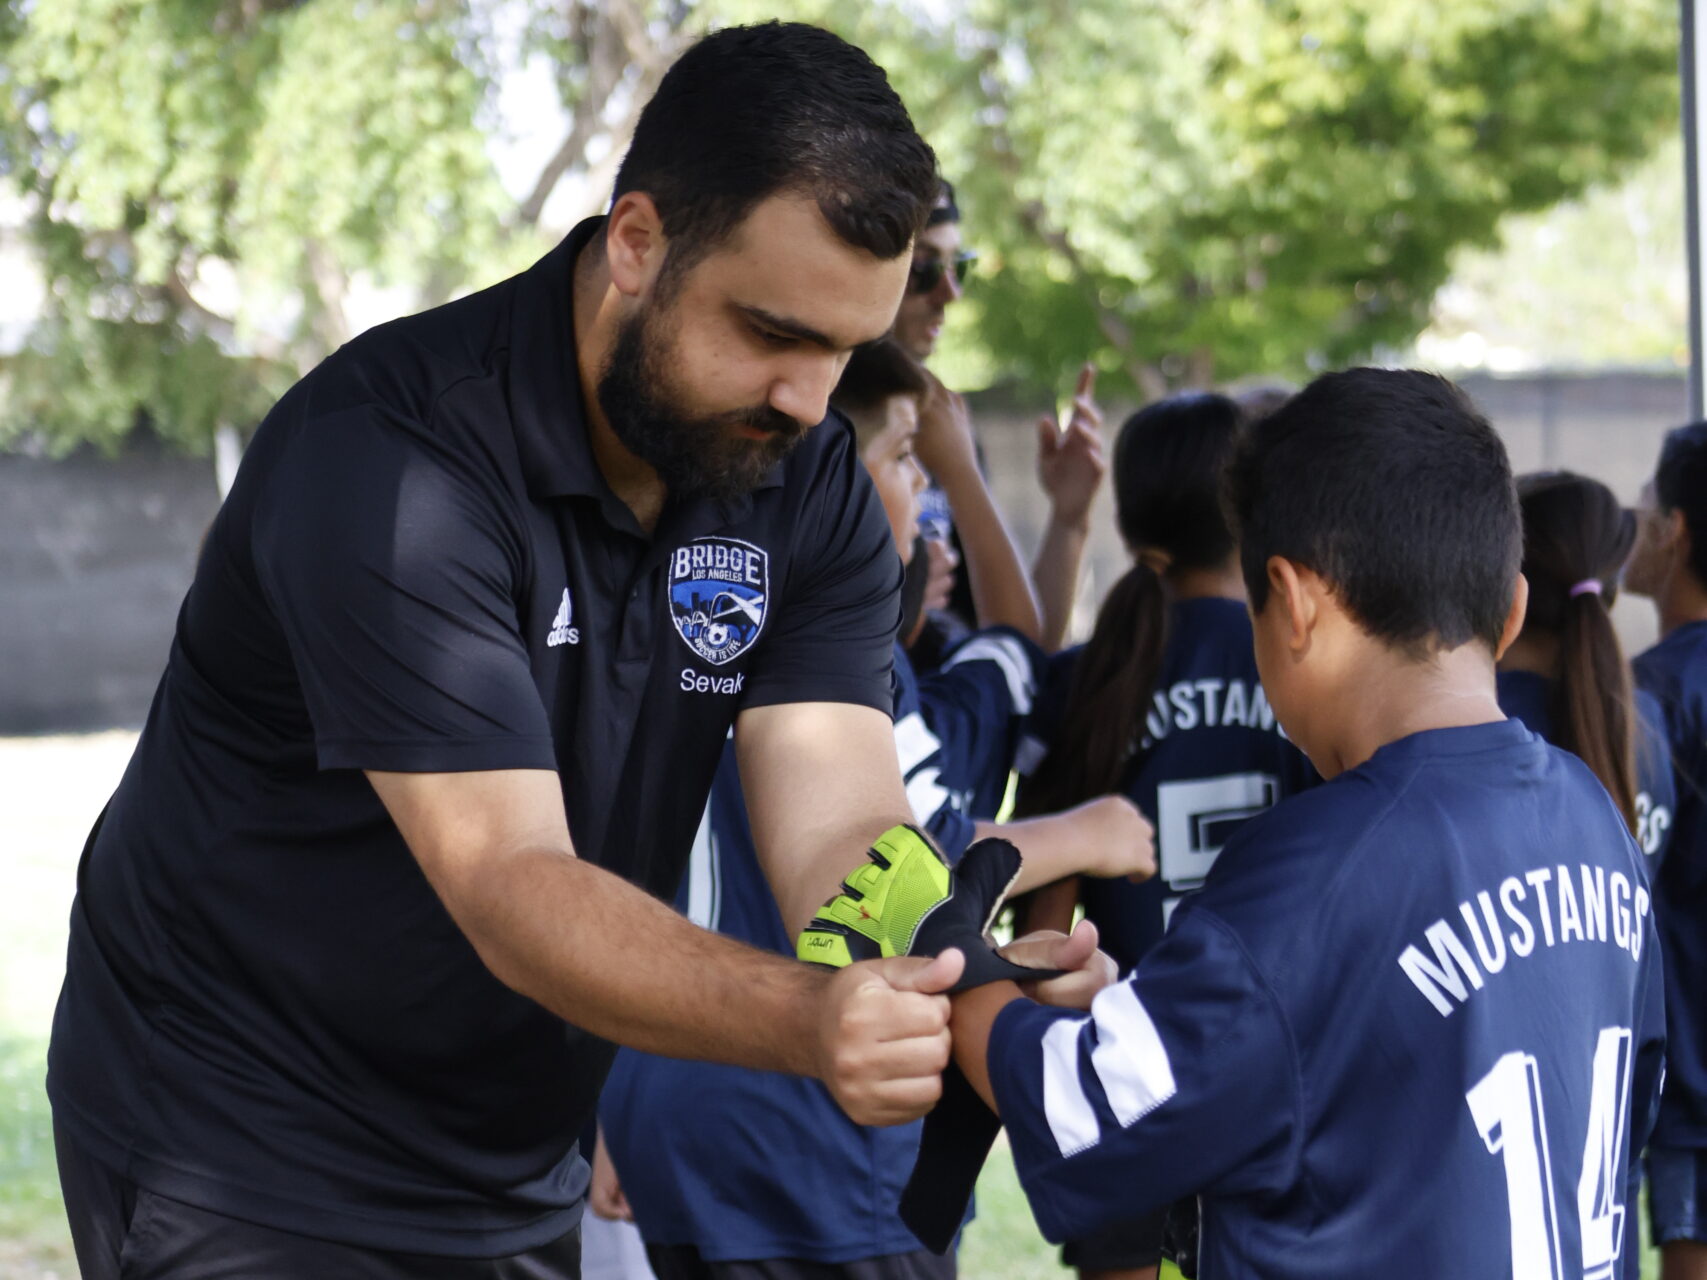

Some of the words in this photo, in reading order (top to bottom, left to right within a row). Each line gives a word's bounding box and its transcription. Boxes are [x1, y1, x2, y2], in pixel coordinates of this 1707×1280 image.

[675, 545, 761, 585] BRIDGE
[692, 570, 706, 580] LOS
[707, 569, 743, 582] ANGELES
[680, 669, 744, 694] Sevak
[1398, 864, 1650, 1018] MUSTANGS
